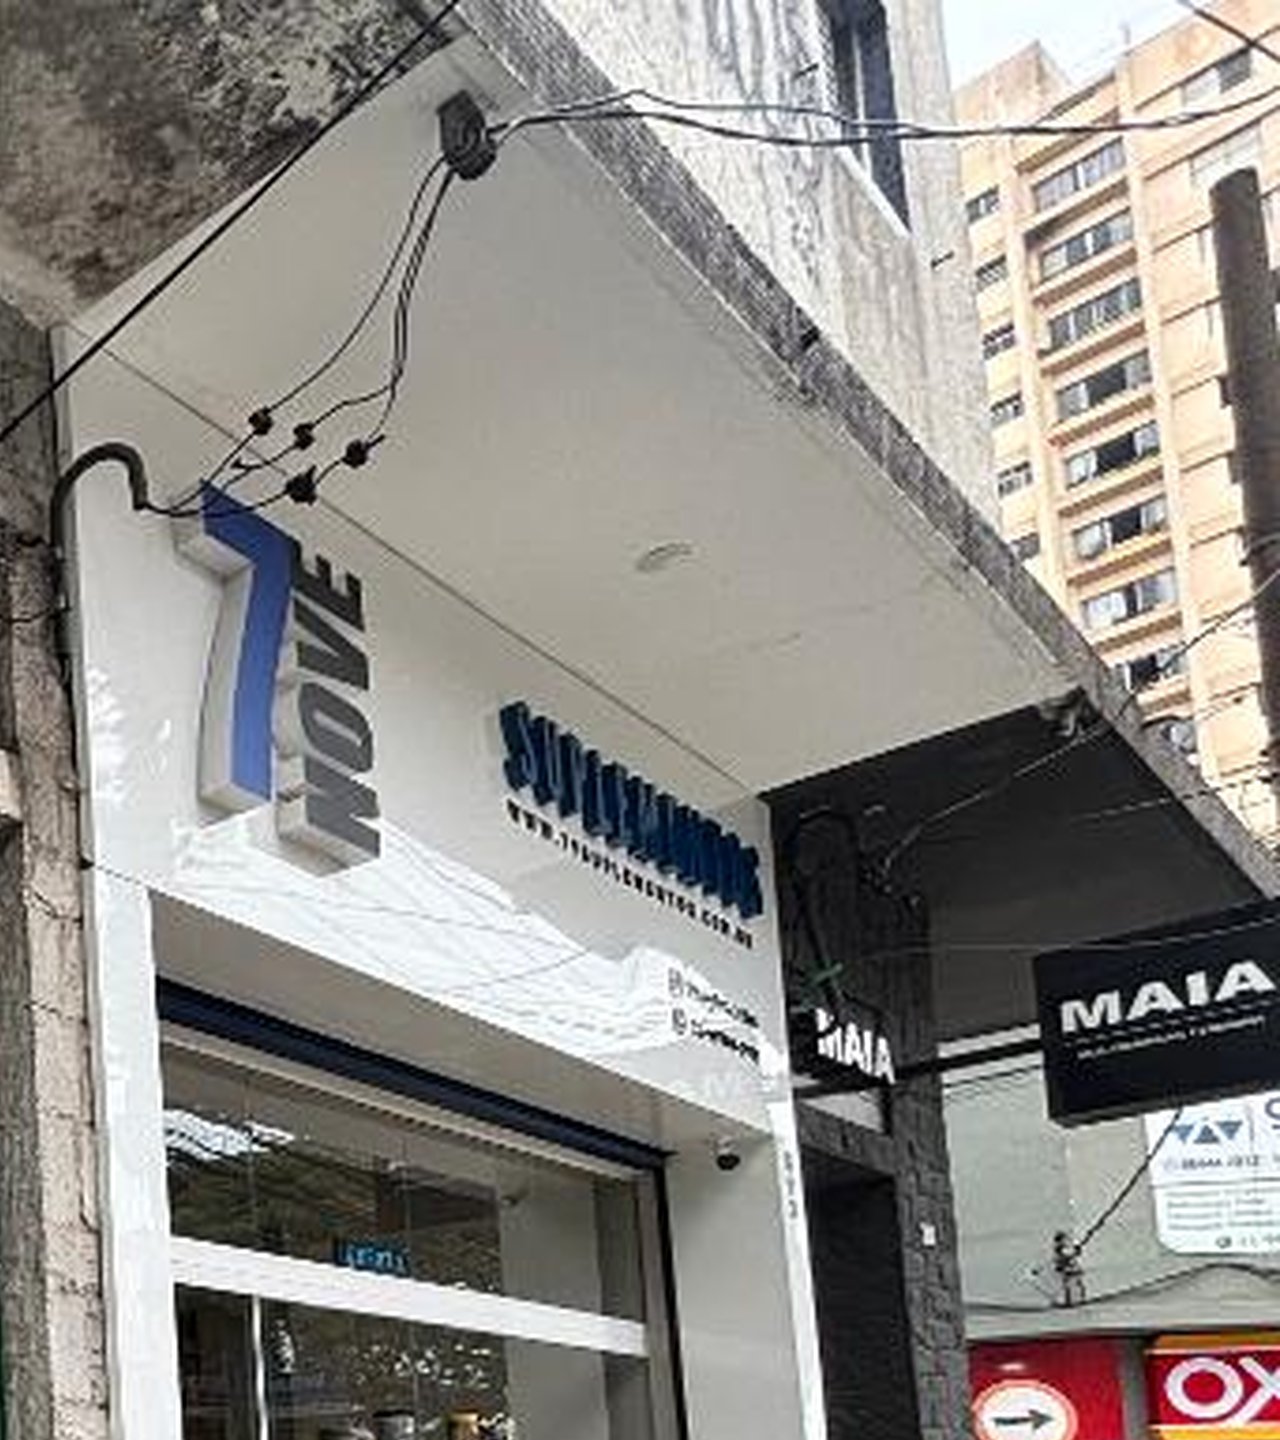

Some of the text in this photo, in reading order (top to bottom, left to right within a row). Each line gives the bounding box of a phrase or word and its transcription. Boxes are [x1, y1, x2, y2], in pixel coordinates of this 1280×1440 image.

[290, 537, 381, 858] NOVE
[1060, 959, 1277, 1034] MAIA
[815, 1007, 896, 1085] MAIA
